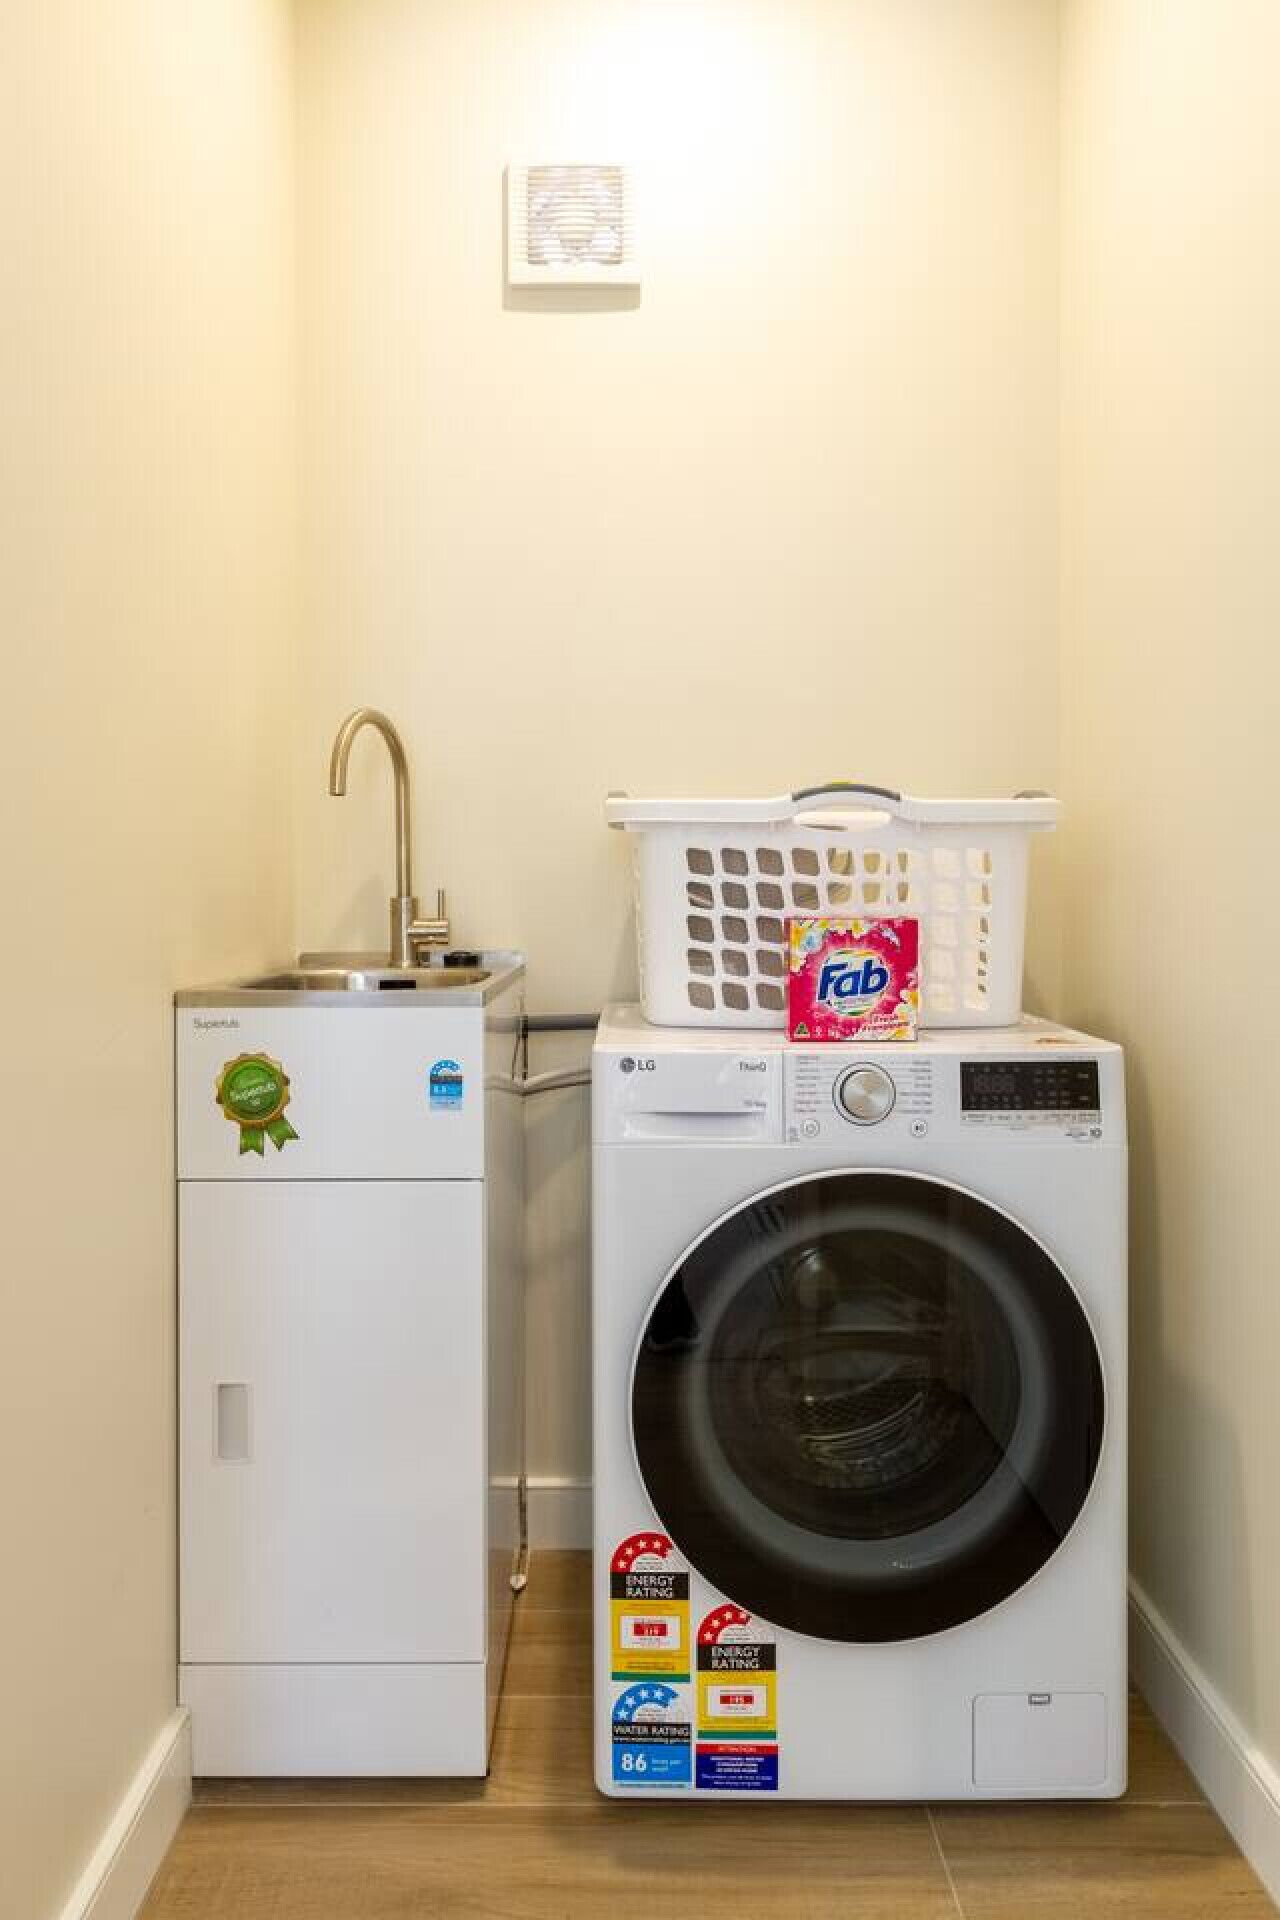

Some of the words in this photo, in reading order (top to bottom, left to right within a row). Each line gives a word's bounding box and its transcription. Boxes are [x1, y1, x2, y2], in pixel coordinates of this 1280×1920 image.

[817, 959, 889, 1001] Fab
[637, 1060, 656, 1071] LG
[625, 1575, 674, 1587] ENERGY
[625, 1587, 673, 1599] RATING
[711, 1645, 760, 1657] ENERGY
[711, 1658, 759, 1669] RATING
[613, 1725, 649, 1735] WATER
[651, 1725, 689, 1737] RATING
[622, 1753, 647, 1773] 86
